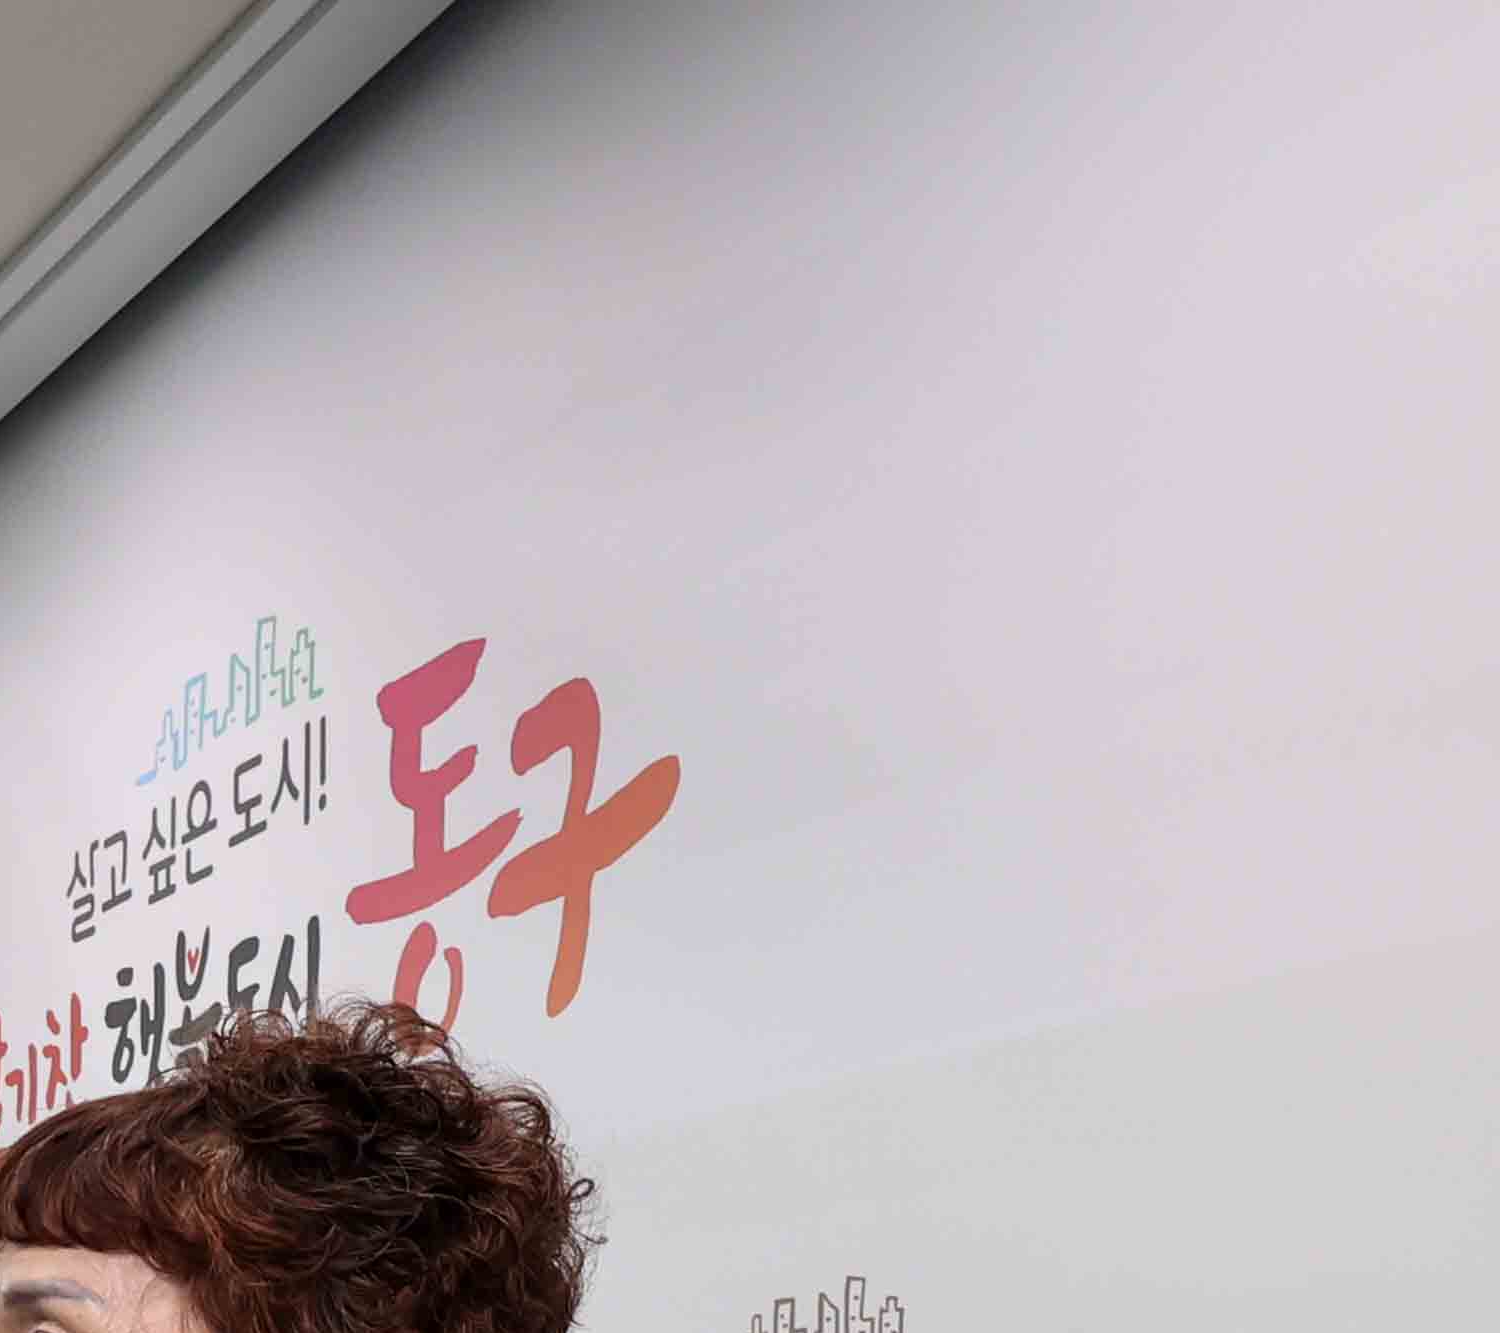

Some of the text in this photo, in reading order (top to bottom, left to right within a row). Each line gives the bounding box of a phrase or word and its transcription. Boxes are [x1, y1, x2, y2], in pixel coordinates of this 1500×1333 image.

[66, 715, 328, 943] 살고 싶은 도시!
[344, 636, 682, 1056] 동구
